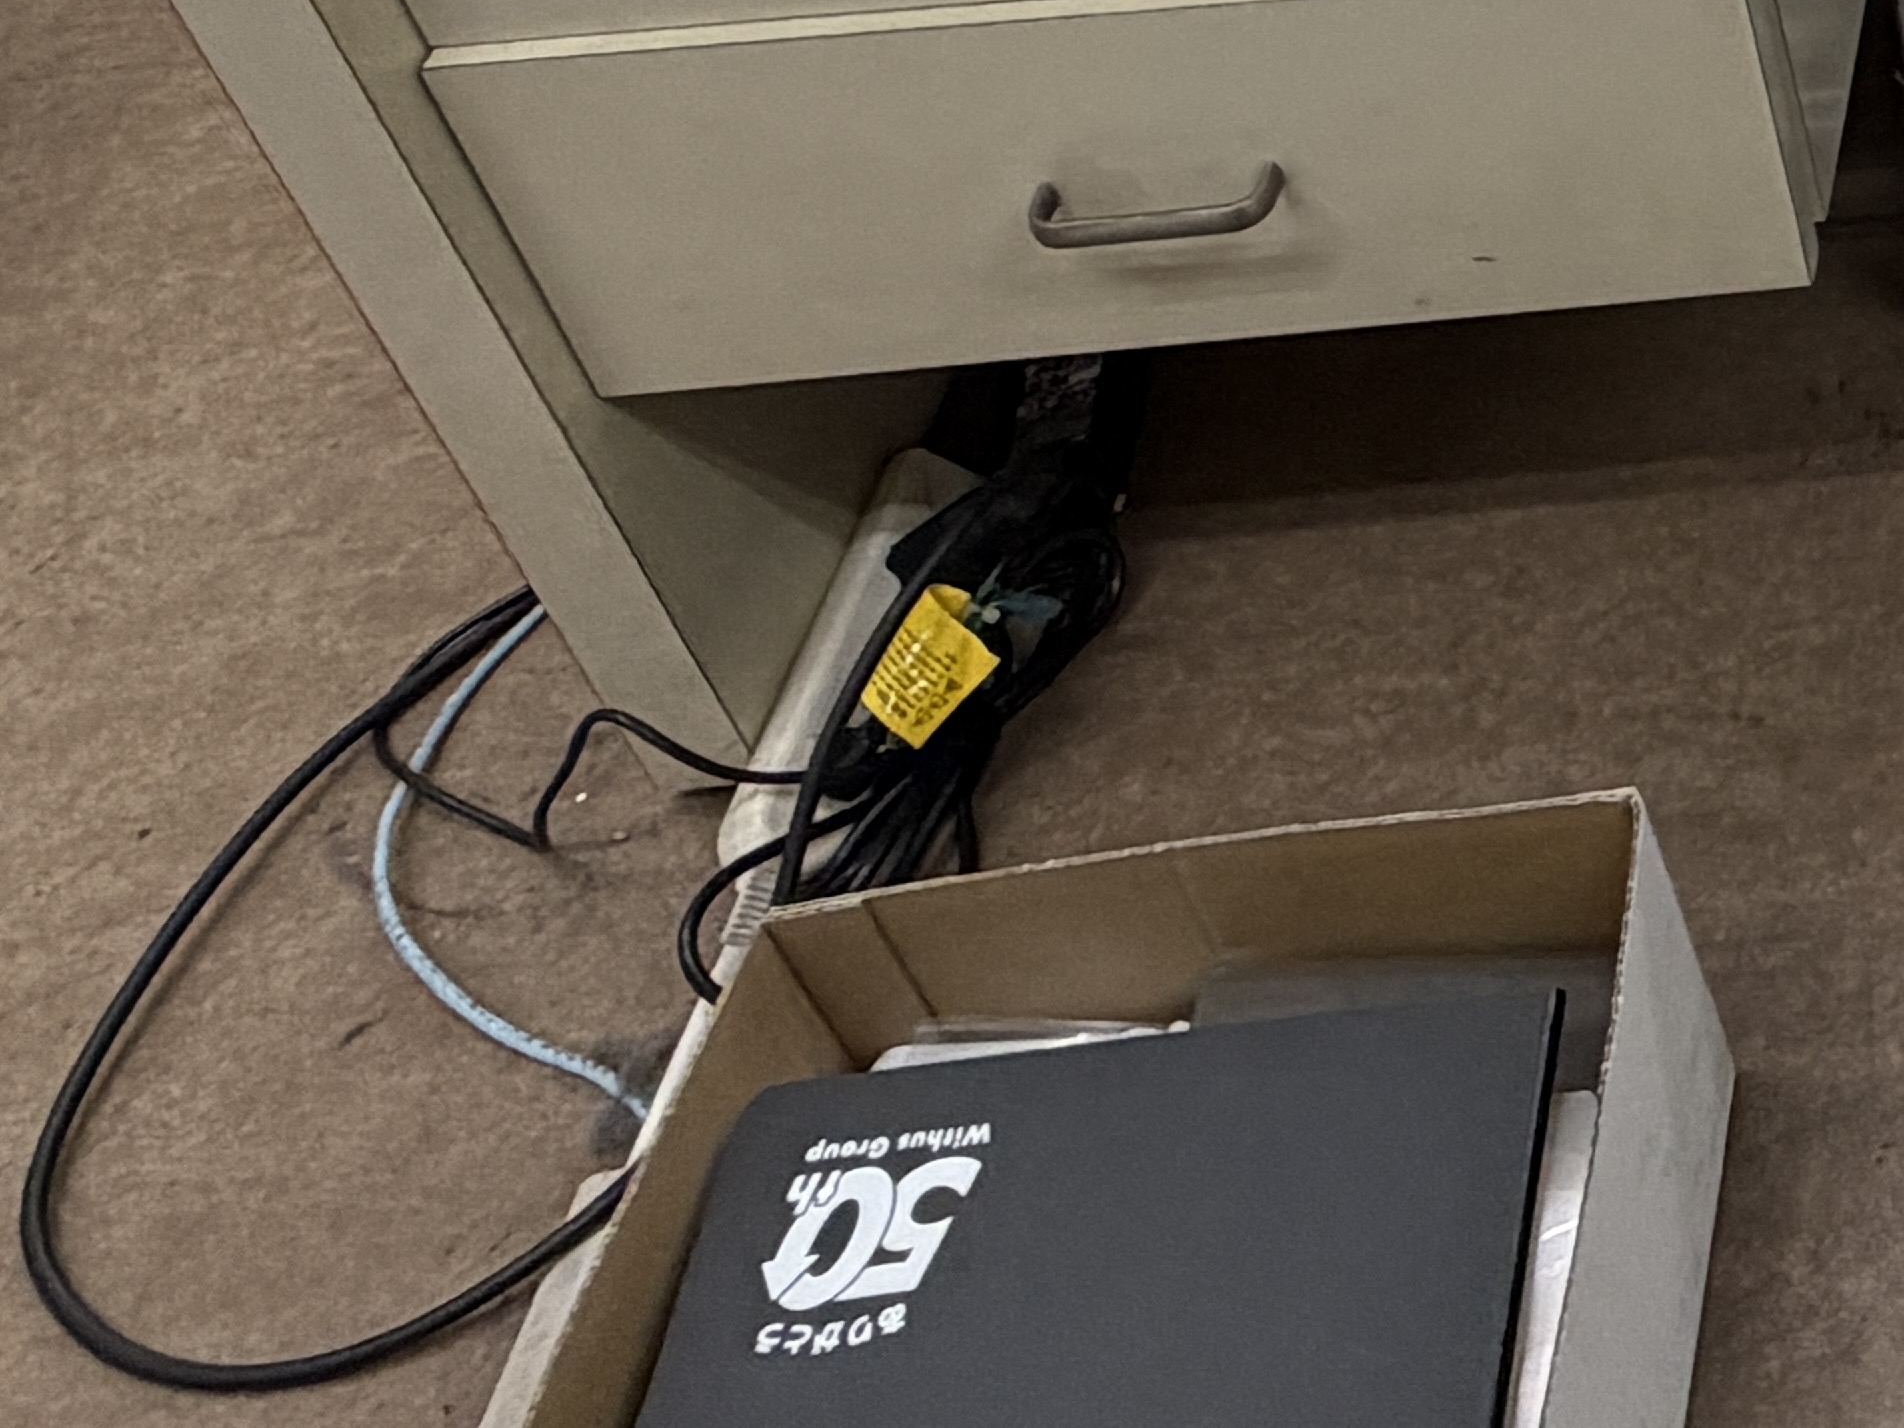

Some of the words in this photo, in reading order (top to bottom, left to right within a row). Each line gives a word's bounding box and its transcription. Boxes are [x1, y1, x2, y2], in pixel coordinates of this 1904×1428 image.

[804, 1135, 891, 1163] Group
[753, 1302, 907, 1356] ありがとう
